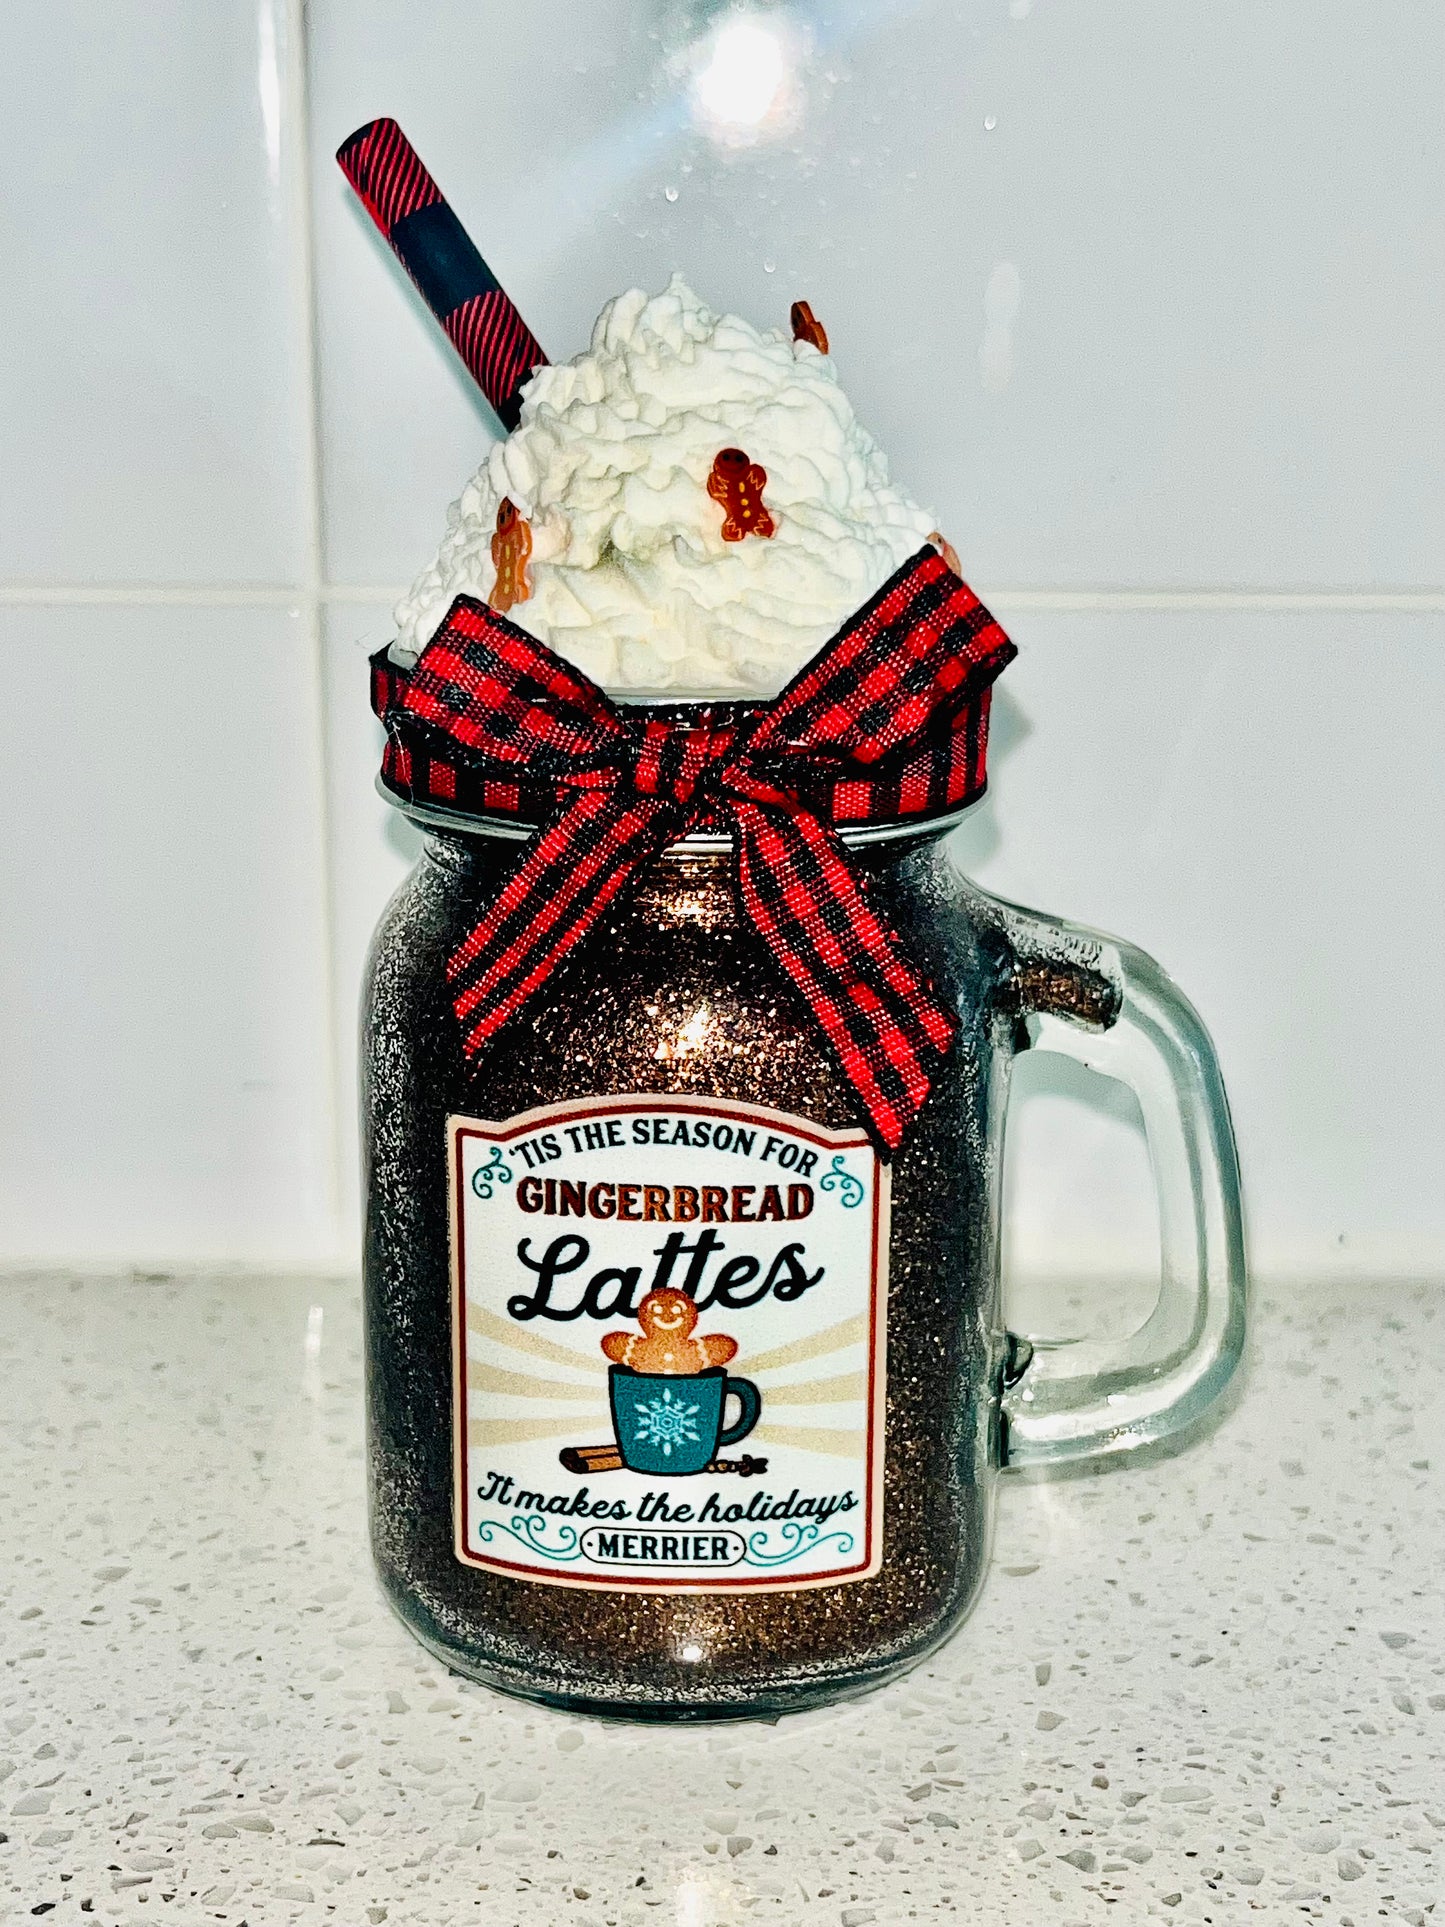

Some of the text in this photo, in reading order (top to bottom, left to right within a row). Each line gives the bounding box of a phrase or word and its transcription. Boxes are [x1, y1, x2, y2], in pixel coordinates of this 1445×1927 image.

[564, 1119, 626, 1161] THE
[632, 1118, 759, 1158] SEASON
[759, 1136, 819, 1177] FOR
[516, 1175, 815, 1223] GINGERBREAD
[507, 1228, 825, 1322] Lattes
[477, 1470, 859, 1526] It makes the holidays
[598, 1534, 729, 1561] MERRIER
